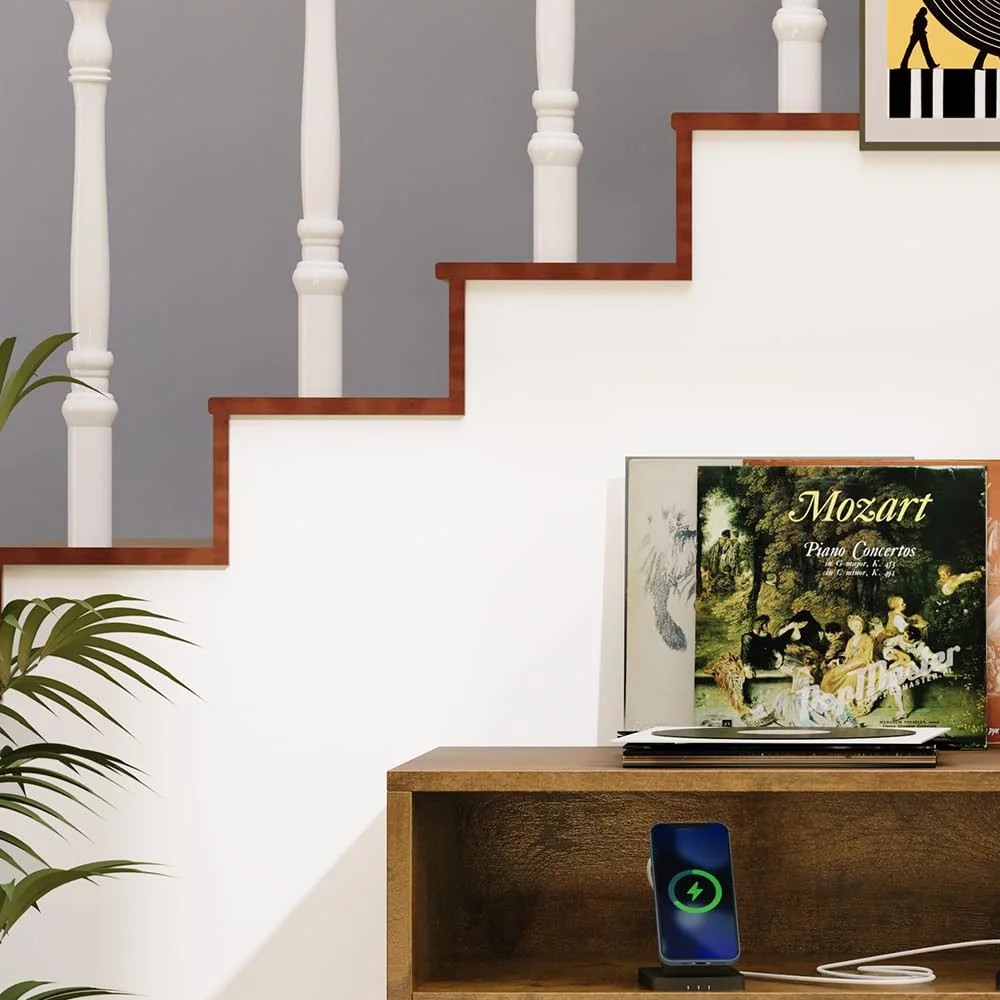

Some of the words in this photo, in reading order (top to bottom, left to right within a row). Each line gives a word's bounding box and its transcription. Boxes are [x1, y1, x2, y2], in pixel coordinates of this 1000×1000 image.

[788, 490, 933, 522] Mozart
[804, 541, 846, 557] Piano
[852, 540, 917, 560] Concertos
[824, 568, 833, 576] in
[836, 568, 844, 576] C
